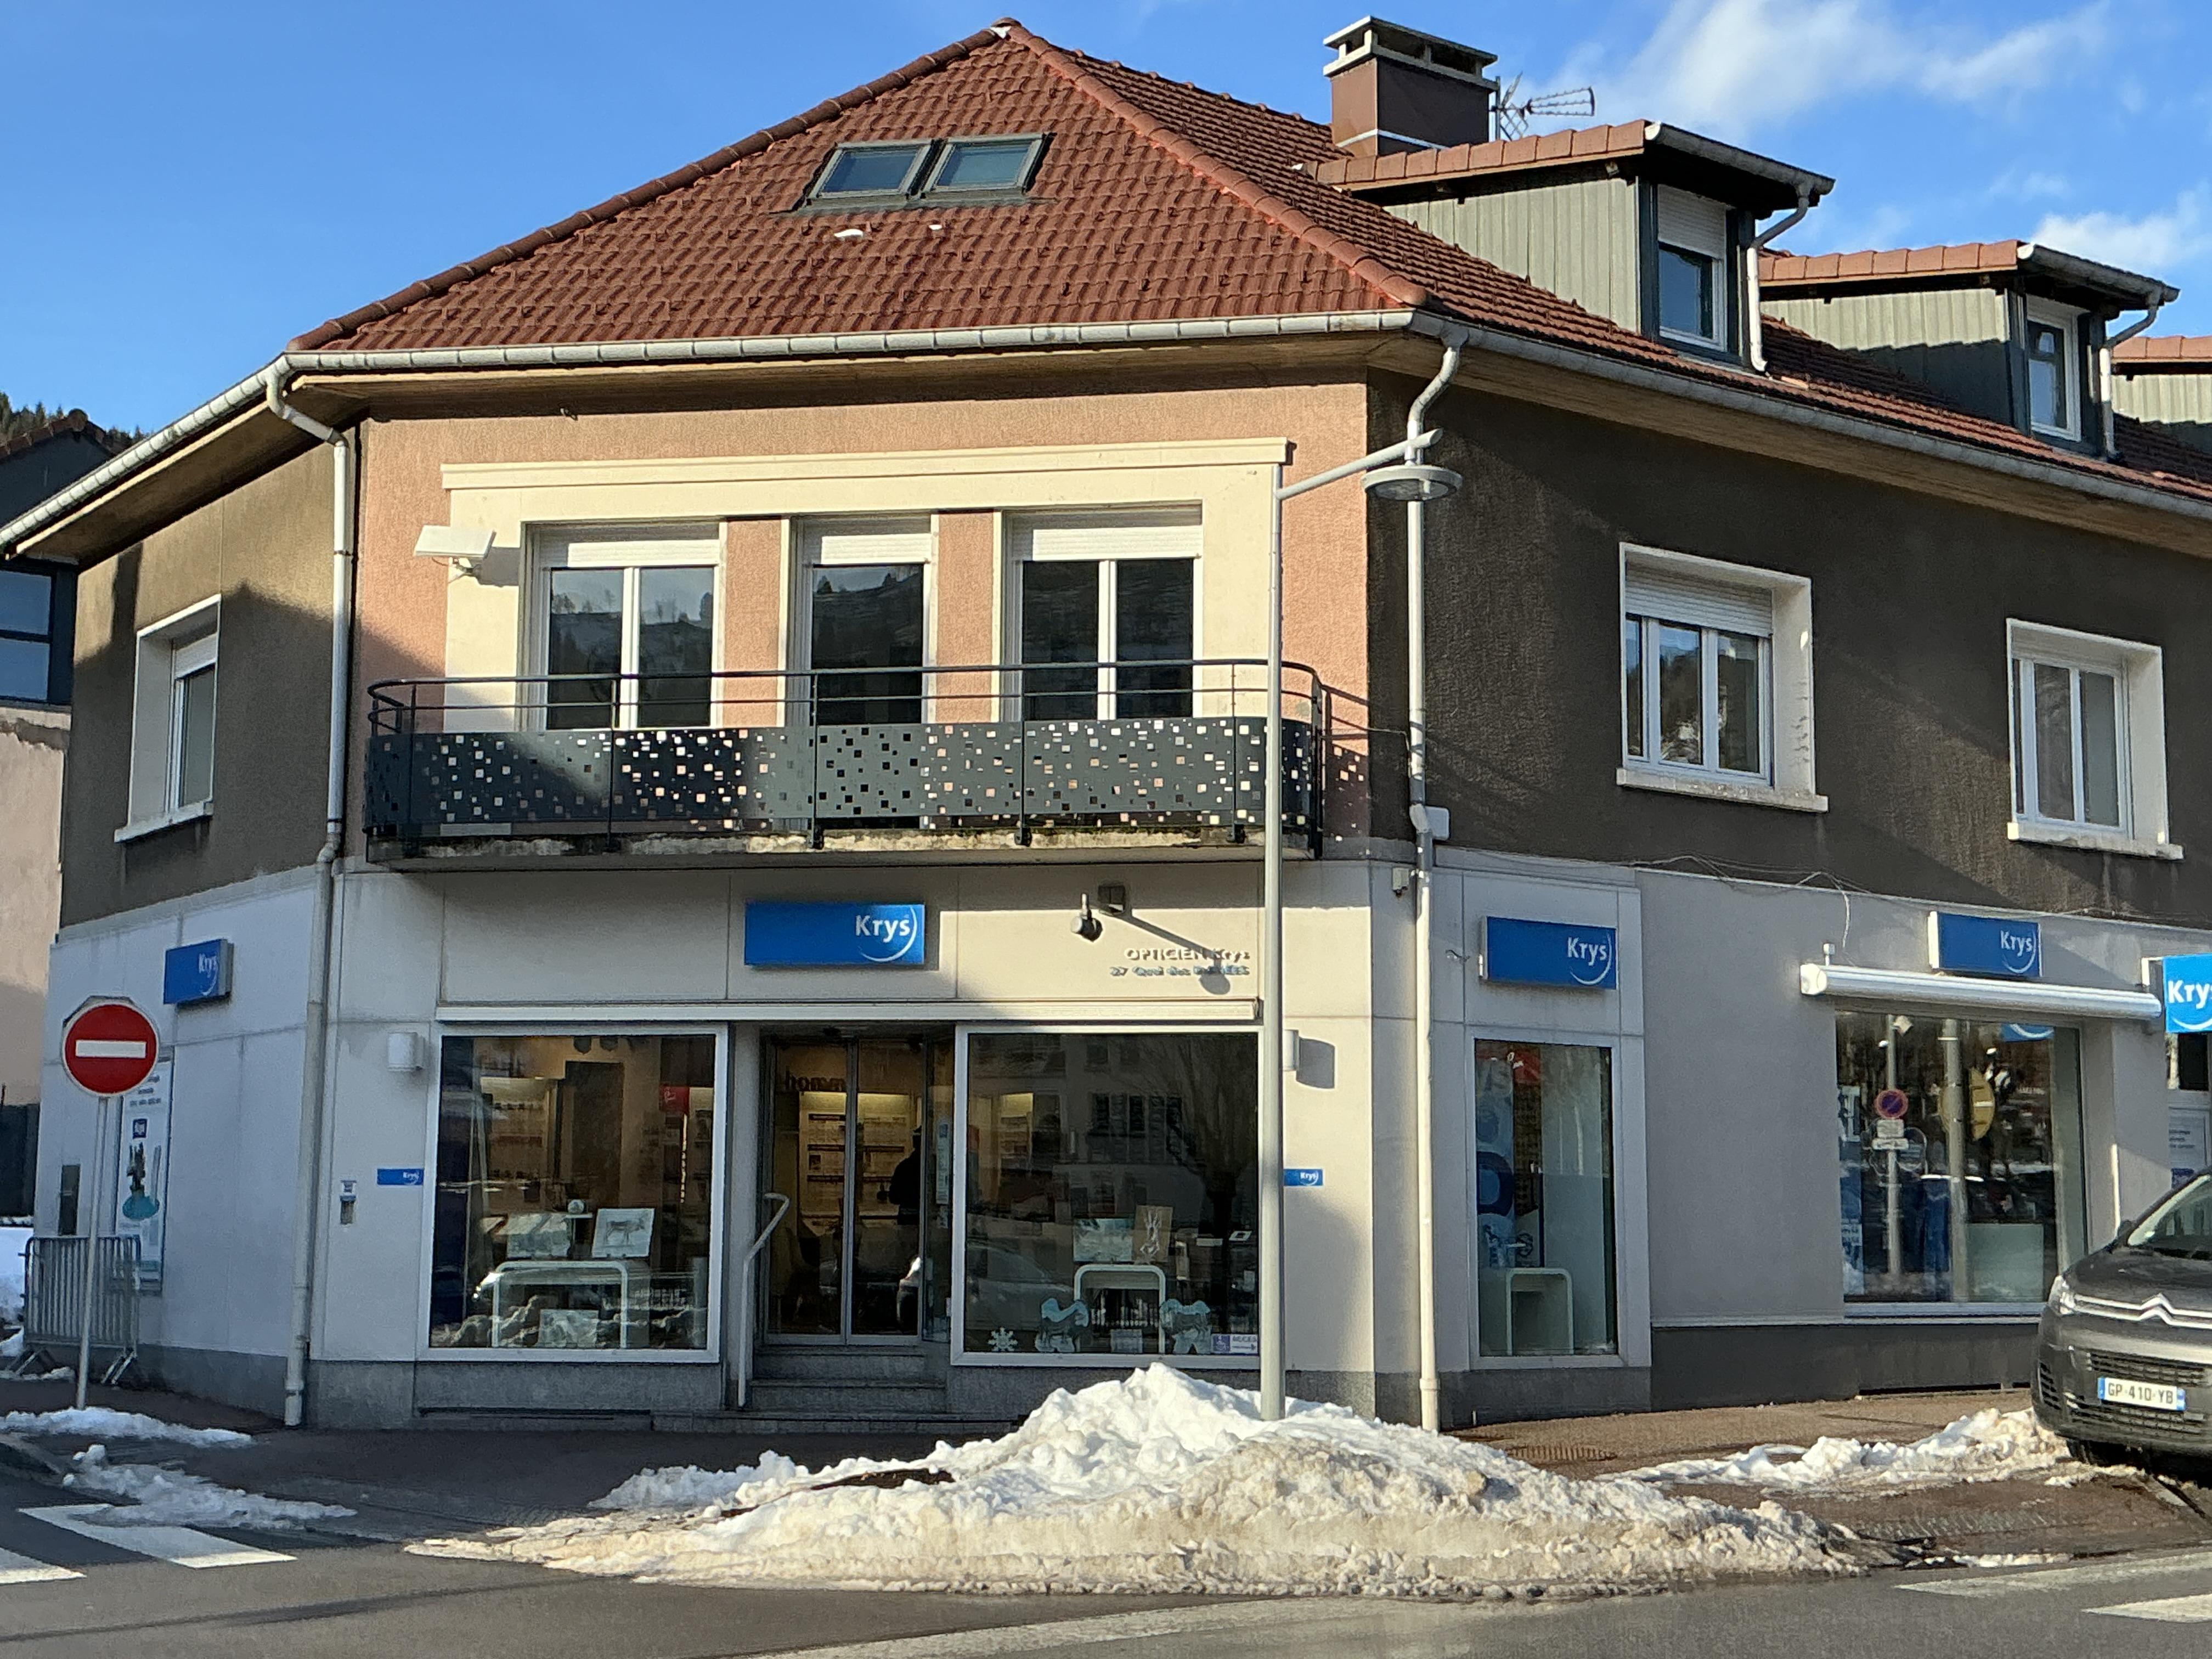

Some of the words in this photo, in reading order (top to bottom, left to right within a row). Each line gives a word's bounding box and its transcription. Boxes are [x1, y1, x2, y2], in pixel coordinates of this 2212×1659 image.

[855, 915, 910, 943] Krys
[1124, 947, 1206, 961] OPTICIEN
[1567, 936, 1607, 966] Krys
[2000, 930, 2032, 957] Krys
[198, 952, 217, 978] Krys
